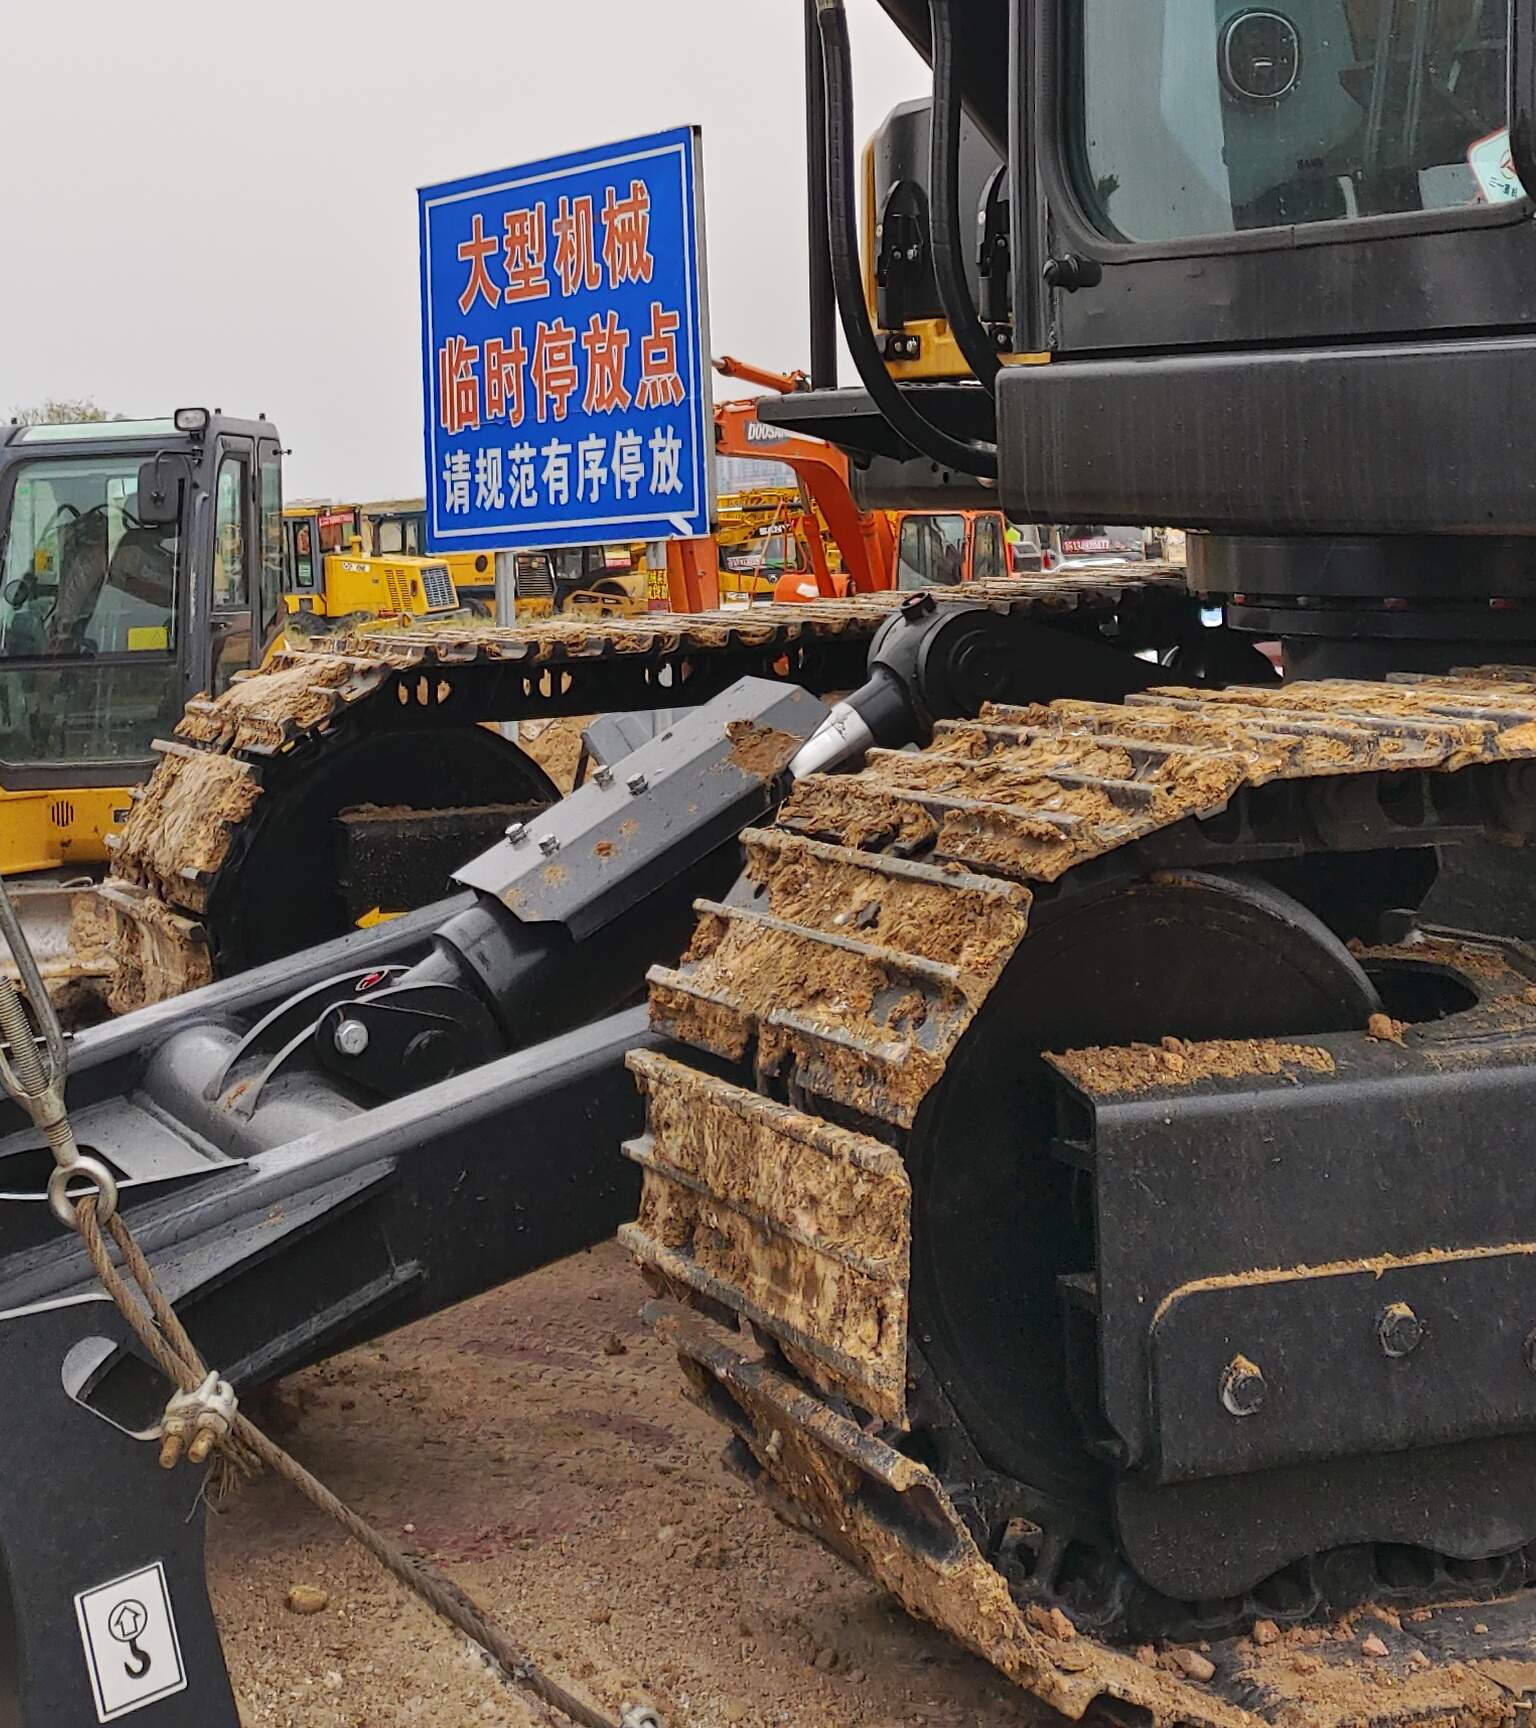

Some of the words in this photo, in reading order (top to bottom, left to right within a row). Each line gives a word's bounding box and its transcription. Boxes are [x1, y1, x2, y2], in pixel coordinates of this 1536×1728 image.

[457, 178, 654, 316] 大型机械
[437, 301, 687, 436] 临时停放点
[442, 425, 684, 516] 请规范有序停放
